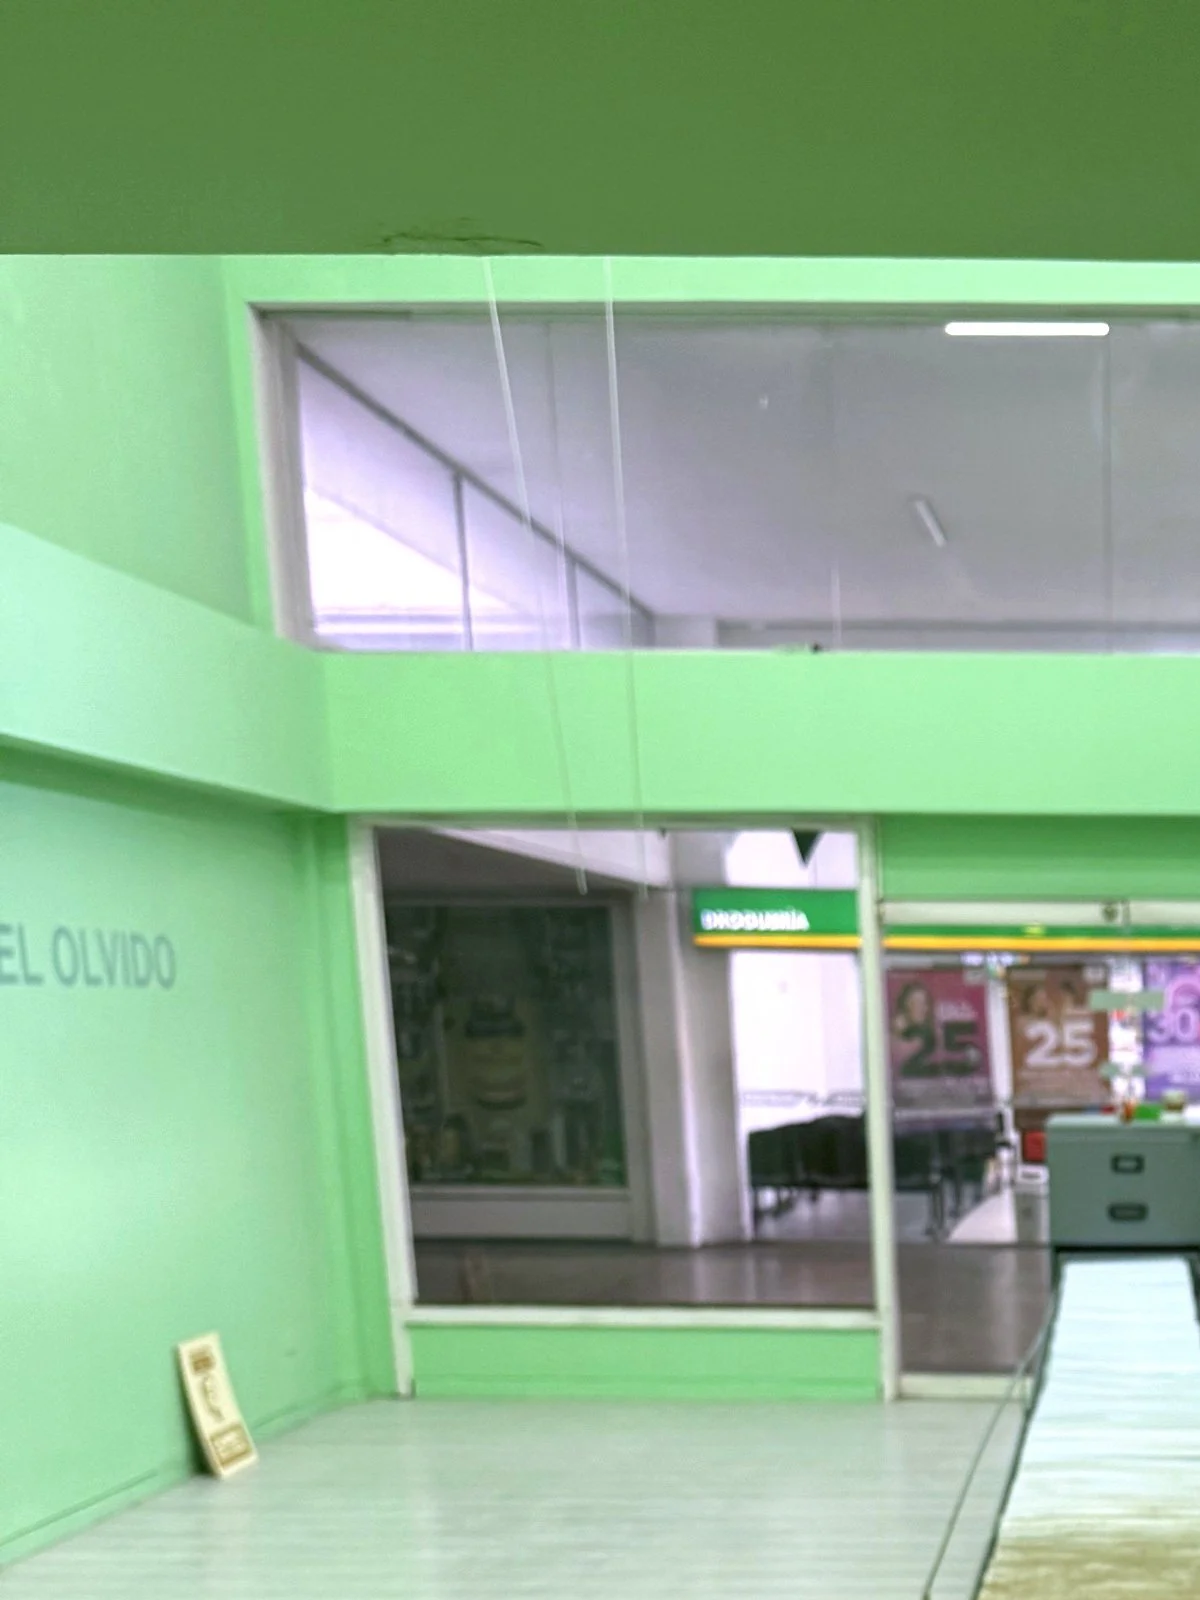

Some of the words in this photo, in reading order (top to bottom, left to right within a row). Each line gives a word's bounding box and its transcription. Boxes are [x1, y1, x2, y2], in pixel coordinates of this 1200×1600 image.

[53, 925, 176, 990] OLVIDO
[902, 1020, 980, 1077] 25
[1025, 1018, 1099, 1067] 25
